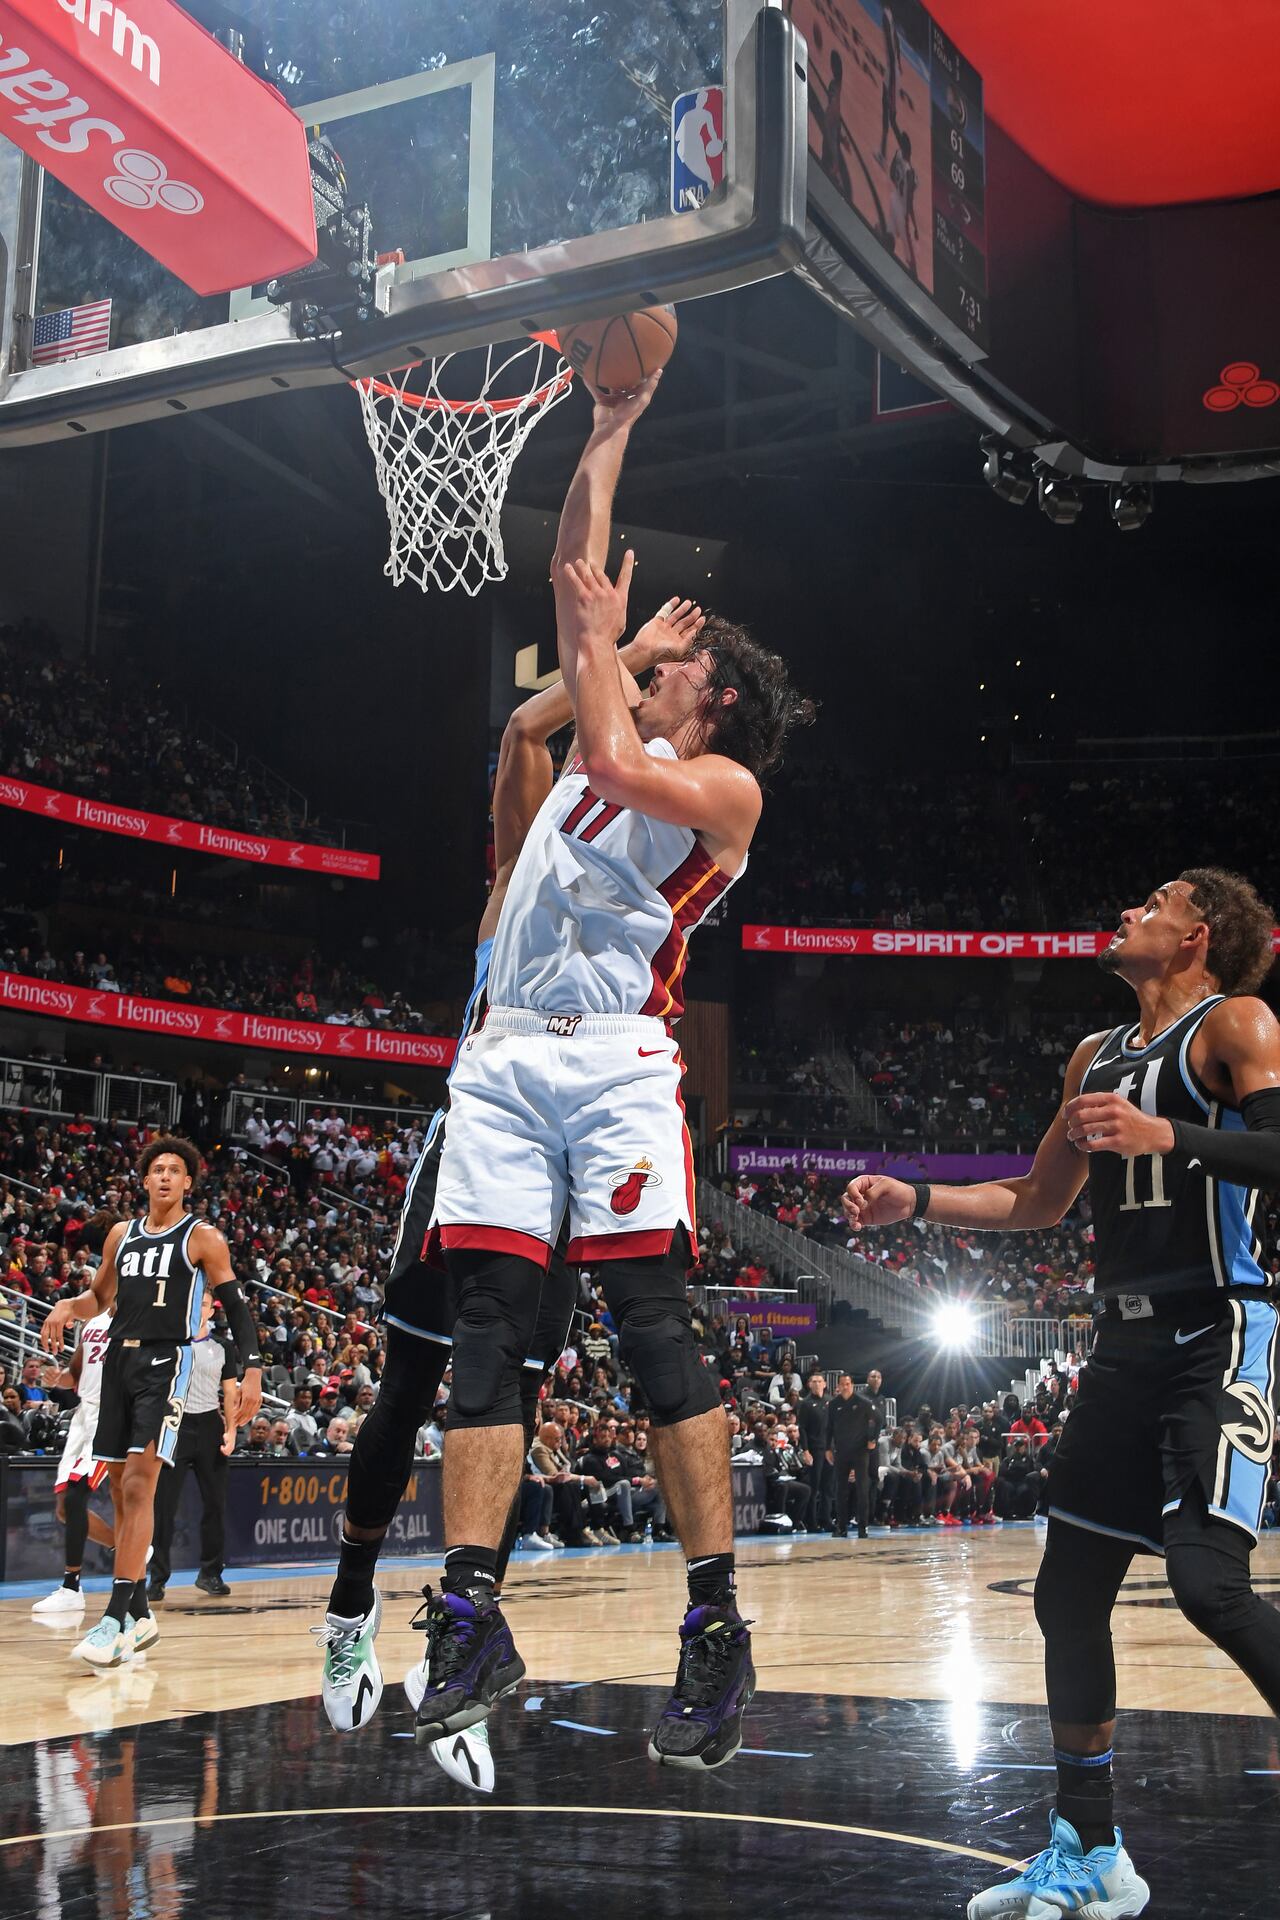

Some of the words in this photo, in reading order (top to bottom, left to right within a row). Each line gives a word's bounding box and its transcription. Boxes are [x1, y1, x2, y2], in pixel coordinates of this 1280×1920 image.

[950, 129, 963, 159] 61
[951, 163, 965, 190] 69
[959, 286, 981, 324] 7:31
[76, 800, 149, 836] Hennessy
[200, 827, 270, 860] Hennessy
[784, 929, 859, 951] Hennessy
[872, 932, 973, 952] SPIRIT
[980, 934, 1024, 954] OF
[1031, 935, 1096, 954] THE
[117, 1000, 203, 1034] Hennessy
[242, 1019, 326, 1050] Hennessy
[365, 1033, 447, 1059] Hennessy
[737, 1150, 798, 1171] planet
[120, 1243, 175, 1278] atl
[152, 1279, 168, 1307] 1
[766, 1311, 810, 1326] fitness
[83, 1328, 109, 1343] HEA
[745, 1471, 755, 1497] A
[254, 1518, 287, 1545] ONE
[290, 1516, 328, 1543] CALL
[407, 1513, 431, 1540] ALL
